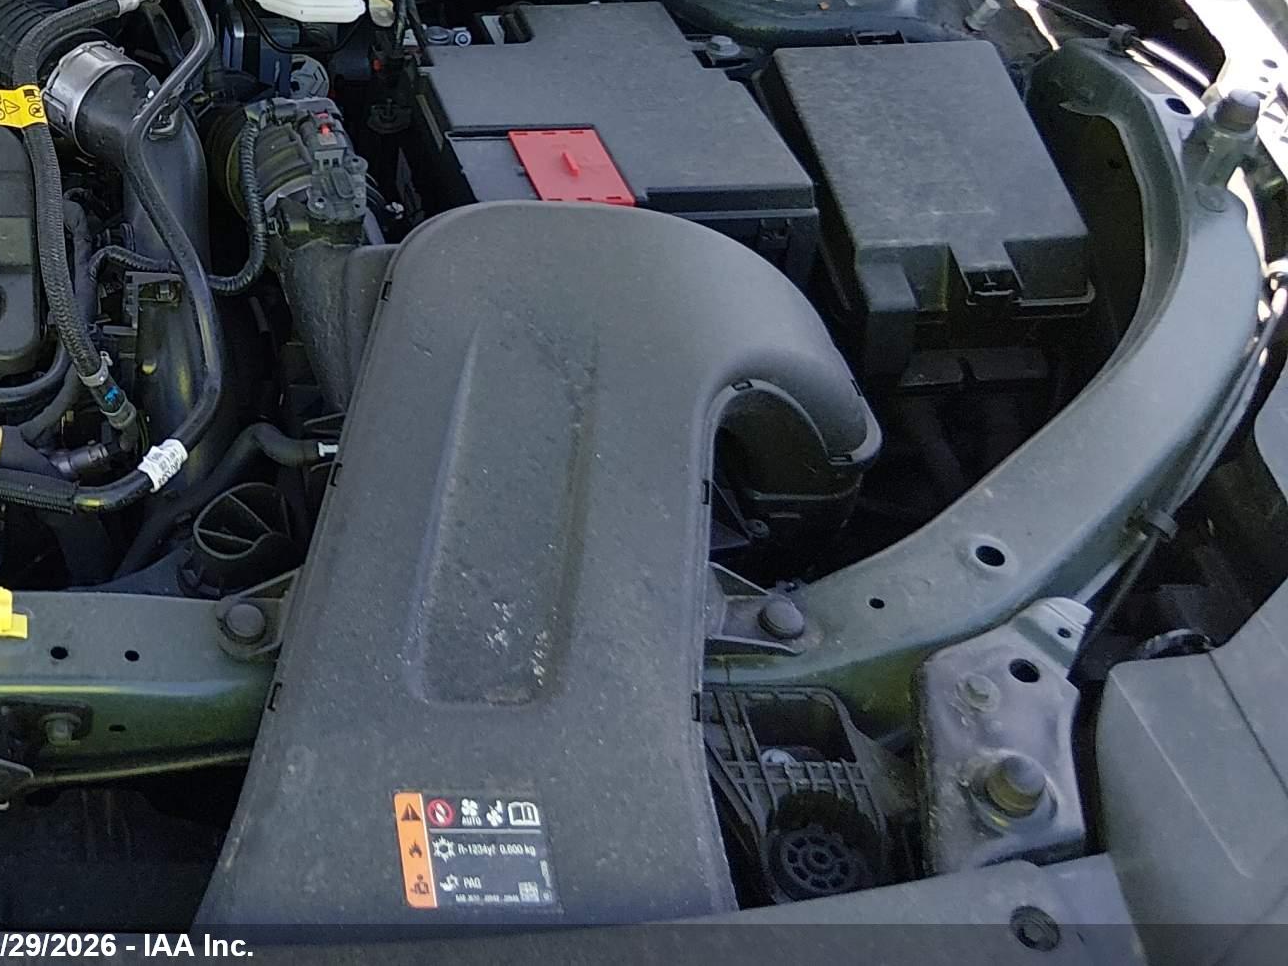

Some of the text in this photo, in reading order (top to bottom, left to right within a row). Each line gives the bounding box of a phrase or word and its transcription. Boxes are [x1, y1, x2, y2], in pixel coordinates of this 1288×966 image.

[462, 815, 482, 827] AUTO
[524, 843, 536, 858] kg
[463, 875, 482, 890] PAG
